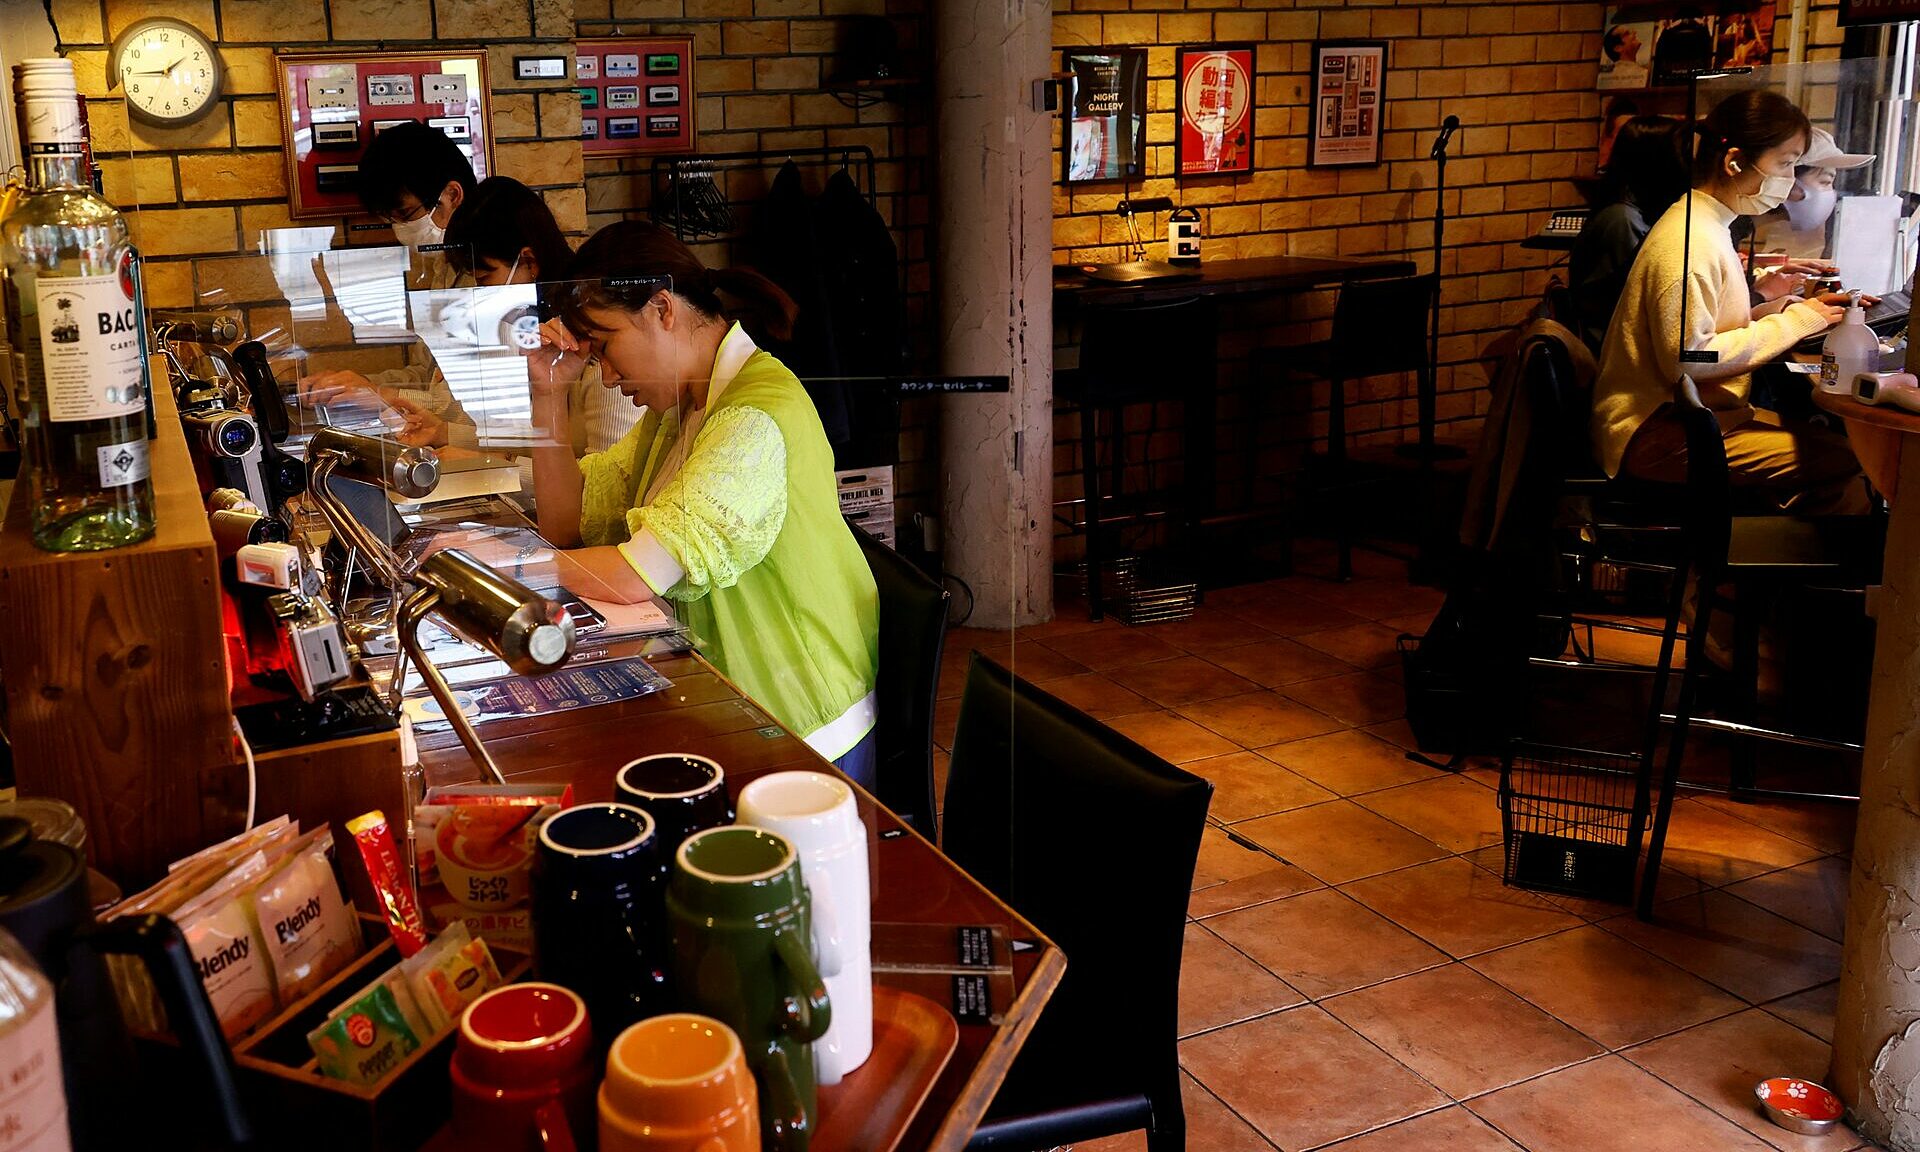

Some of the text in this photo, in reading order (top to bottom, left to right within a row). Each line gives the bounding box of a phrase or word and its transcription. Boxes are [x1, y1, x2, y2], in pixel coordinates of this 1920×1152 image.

[159, 33, 169, 42] 12
[181, 39, 185, 48] 1
[131, 49, 141, 59] 10
[194, 51, 200, 61] 2
[126, 67, 132, 75] 9
[200, 69, 206, 78] 3
[133, 84, 139, 93] 8
[148, 96, 154, 105] 7
[183, 97, 189, 106] 5
[1093, 93, 1119, 102] NIGHT
[165, 101, 171, 110] 6
[1088, 102, 1124, 111] GALLERY
[97, 308, 136, 335] BAC
[469, 876, 508, 889] じっくり
[468, 890, 510, 902] コトコト
[275, 896, 321, 944] Blendy
[200, 936, 249, 978] lendy
